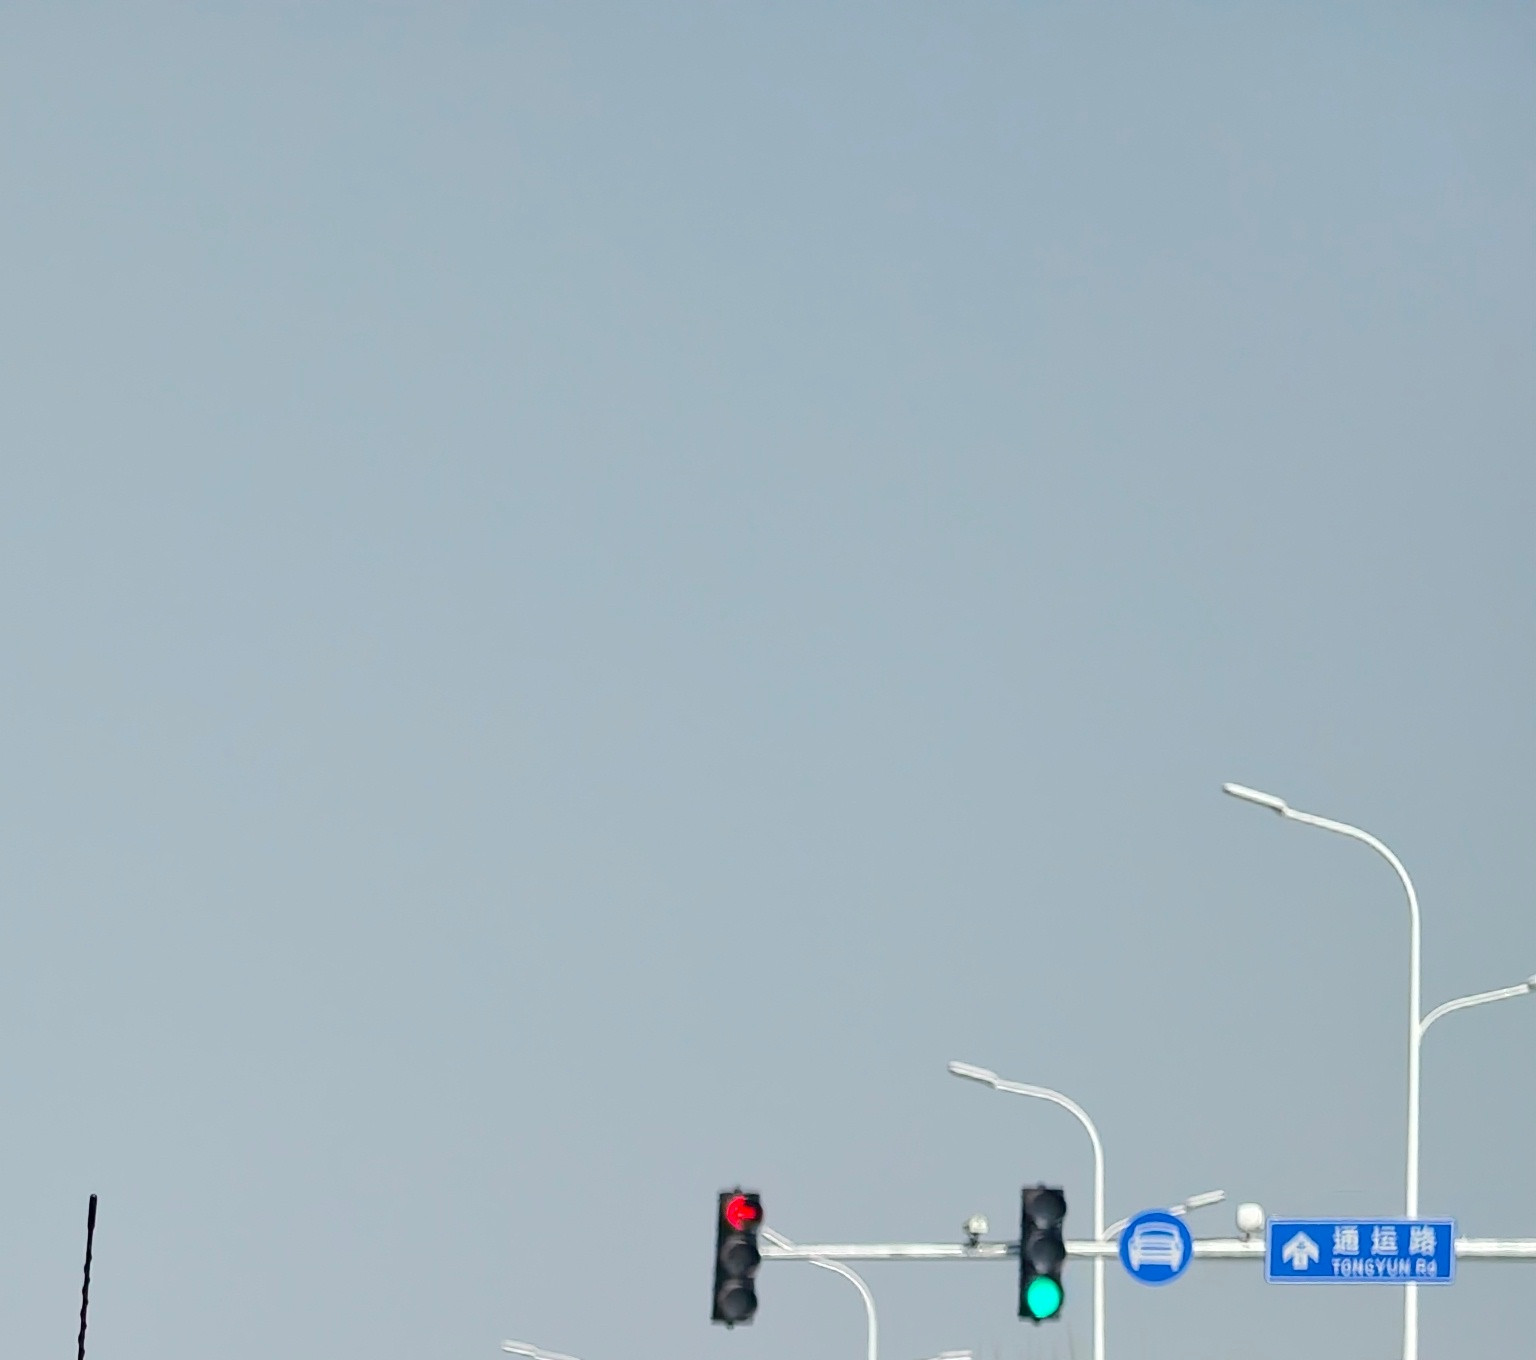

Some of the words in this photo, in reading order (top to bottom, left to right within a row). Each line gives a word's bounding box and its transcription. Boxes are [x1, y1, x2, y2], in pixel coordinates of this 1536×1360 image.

[1331, 1225, 1437, 1257] 通运路
[1331, 1258, 1411, 1277] TONGYUN
